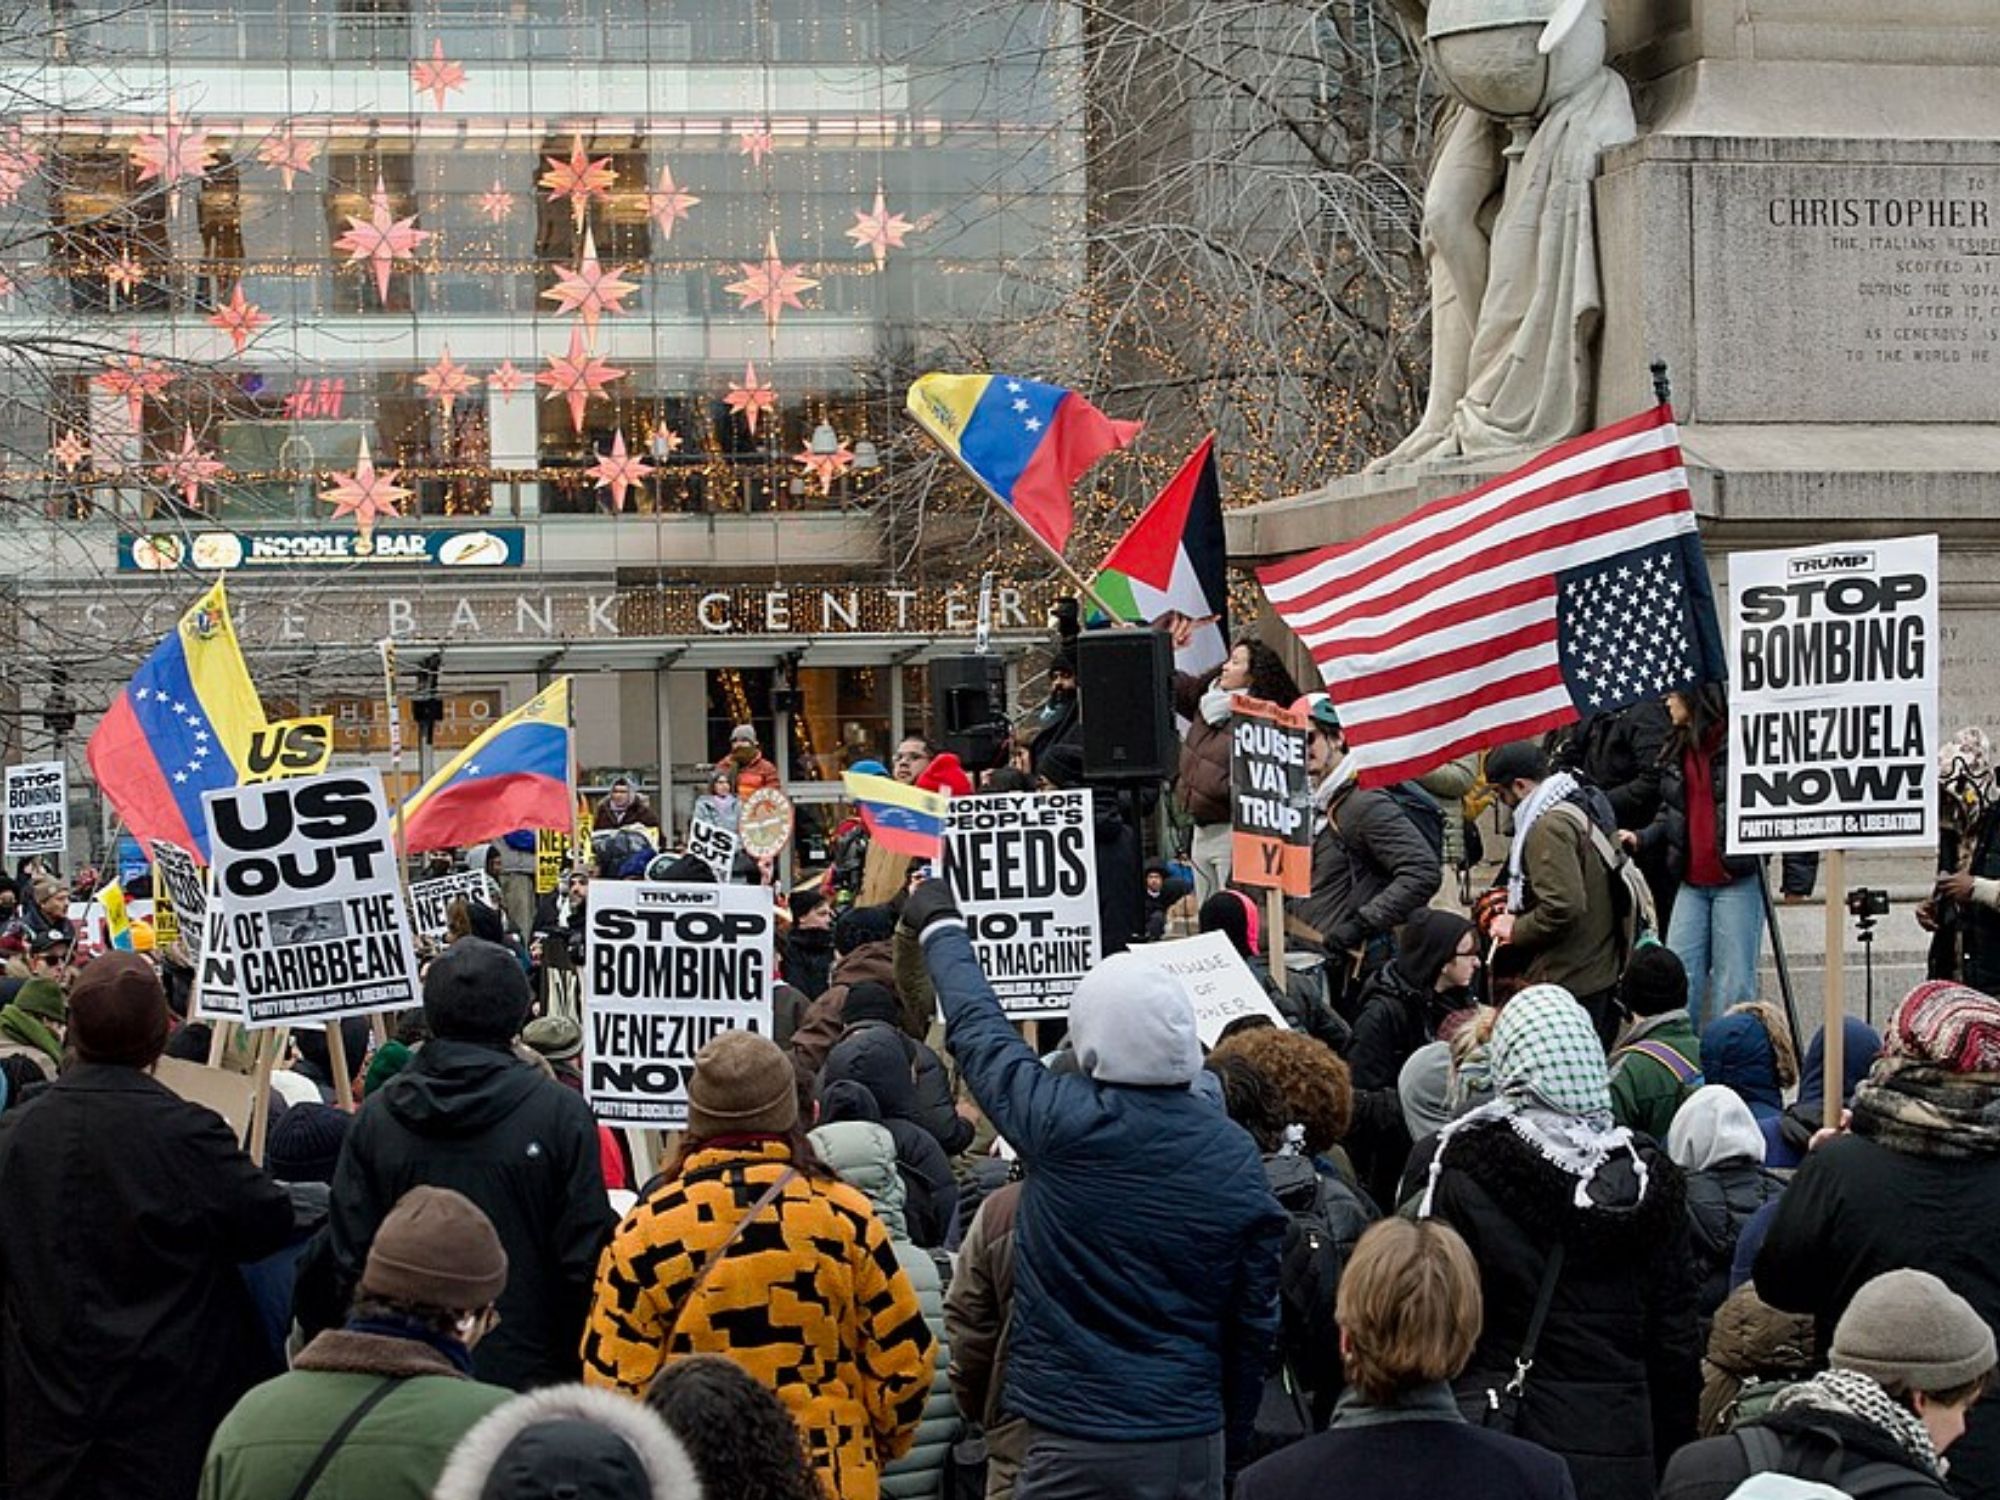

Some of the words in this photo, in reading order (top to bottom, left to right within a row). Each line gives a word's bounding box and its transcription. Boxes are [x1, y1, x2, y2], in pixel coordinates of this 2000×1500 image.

[1769, 198, 1989, 227] CHRISTOPHER
[253, 534, 349, 556] NOODLE
[376, 534, 427, 555] BAR
[1792, 555, 1868, 573] TRUMP
[387, 596, 620, 637] BANK
[698, 588, 1028, 631] CENTER
[1740, 573, 1927, 623] STOP
[1740, 614, 1925, 692] BOMBING
[248, 724, 327, 774] US
[1740, 703, 1926, 767] VENEZUELA
[10, 773, 62, 789] STOP
[1033, 794, 1083, 810] FOR
[1740, 763, 1926, 809] NOW!
[211, 780, 377, 851] US
[694, 821, 733, 852] US
[1844, 815, 1859, 833] &
[225, 840, 385, 897] OUT
[690, 841, 731, 865] OUT
[943, 826, 1088, 902] NEEDS
[641, 891, 713, 903] TRUMP
[234, 913, 263, 950] OF
[347, 893, 399, 935] THE
[593, 908, 767, 944] STOP
[1055, 924, 1093, 938] THE
[242, 934, 407, 996] CARIBBEAN
[593, 943, 764, 1001] BOMBING
[996, 939, 1093, 977] MACHINE
